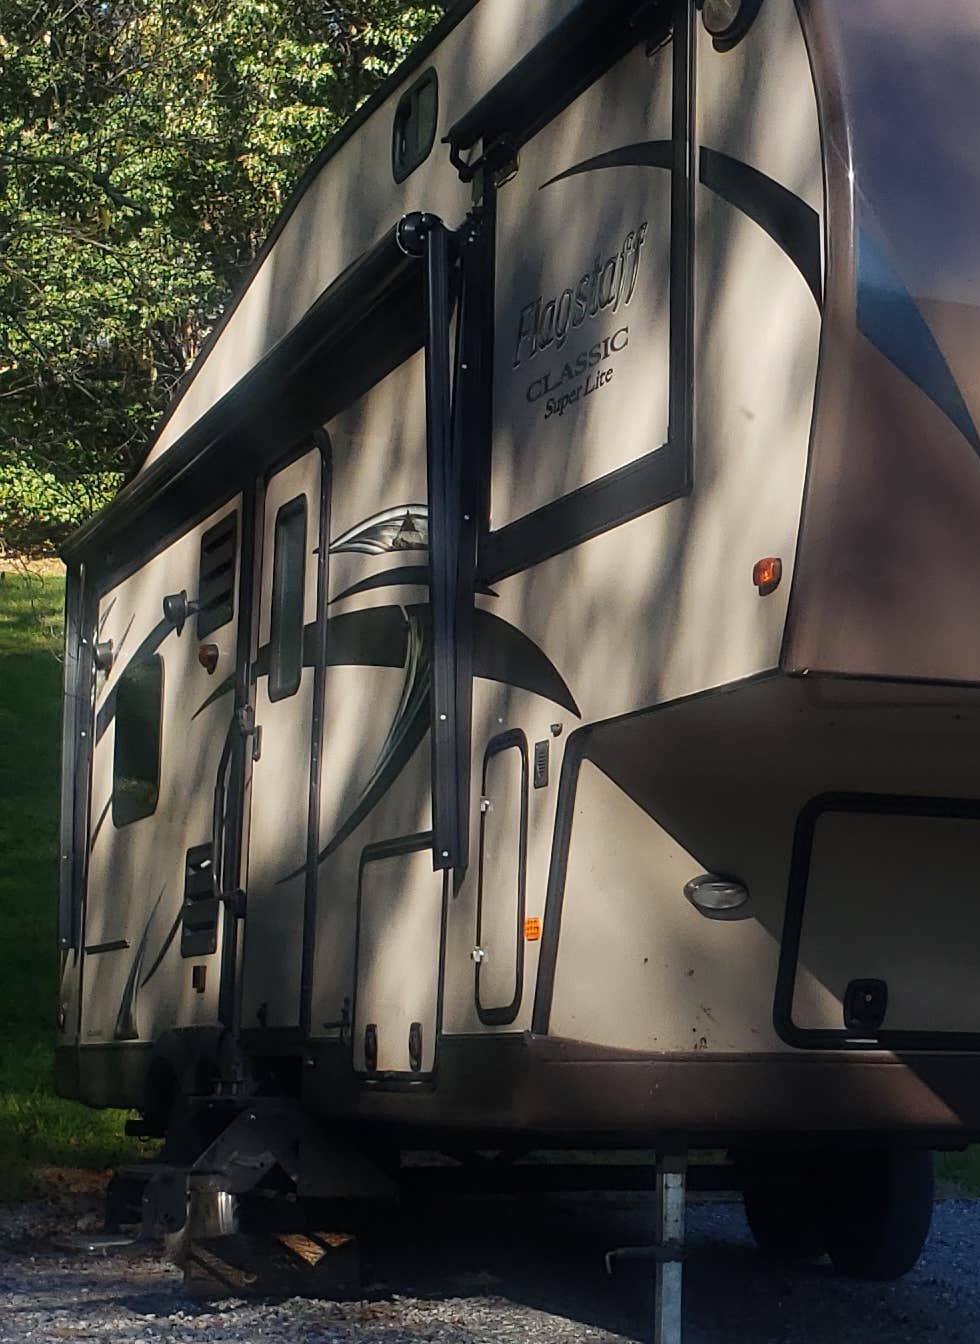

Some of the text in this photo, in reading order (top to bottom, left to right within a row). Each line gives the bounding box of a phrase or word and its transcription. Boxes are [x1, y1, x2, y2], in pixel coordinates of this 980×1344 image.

[512, 221, 648, 369] Flagstaff
[526, 326, 629, 403] CLASSIC
[543, 367, 614, 420] Super Lite
